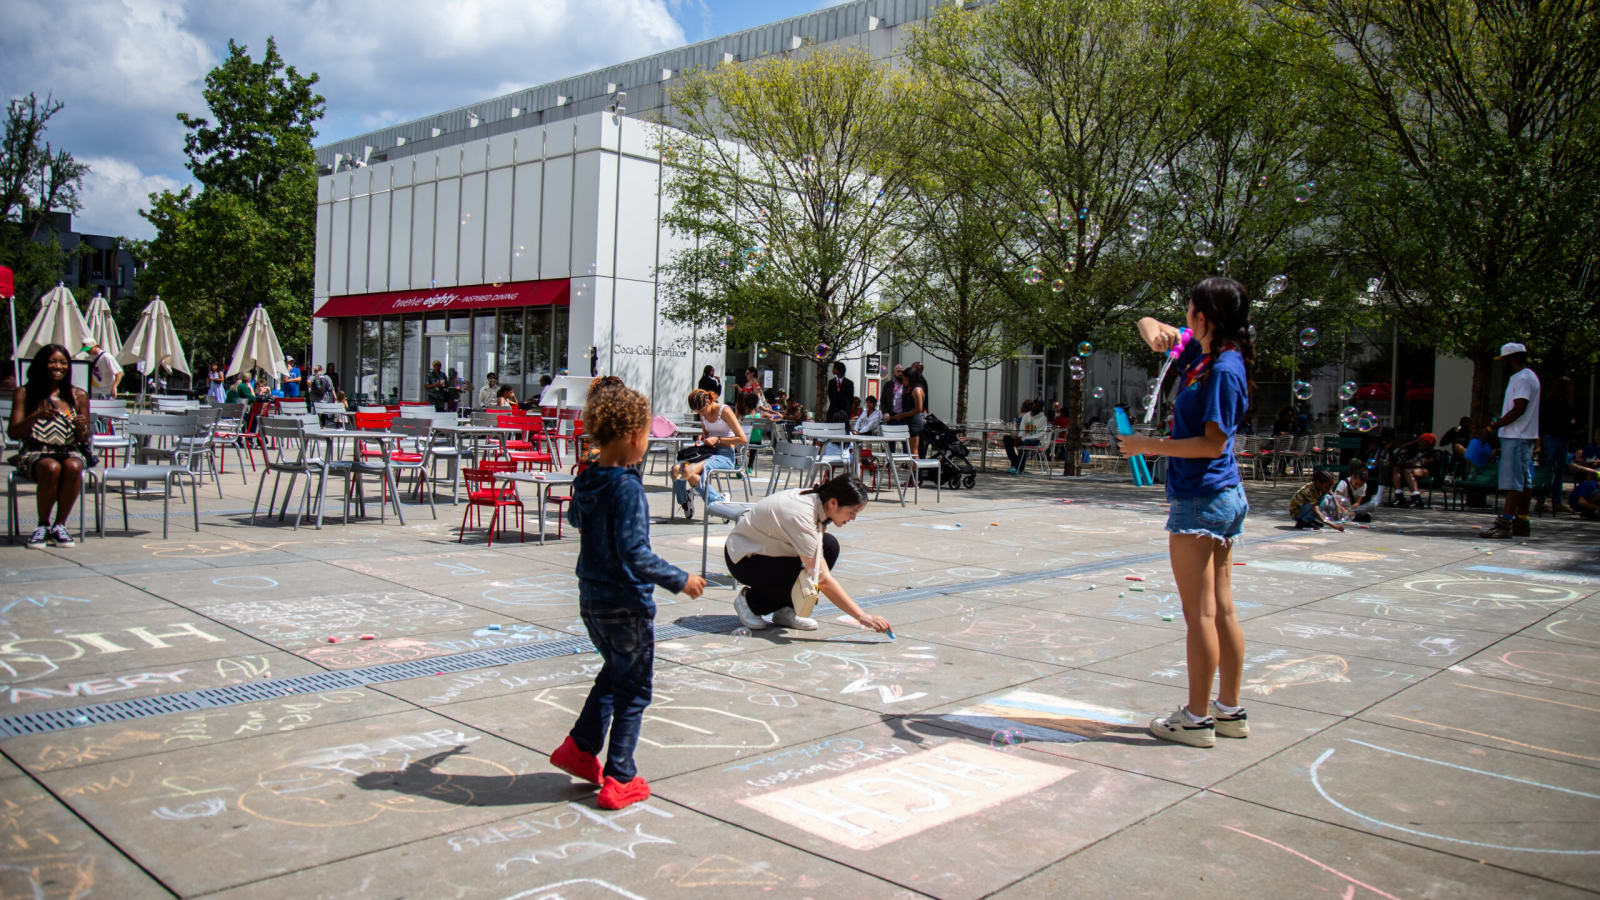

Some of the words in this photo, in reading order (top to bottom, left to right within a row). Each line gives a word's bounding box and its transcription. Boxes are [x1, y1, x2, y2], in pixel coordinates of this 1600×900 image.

[392, 296, 424, 308] twelve
[423, 292, 459, 308] eighty
[460, 294, 492, 303] INSPIRED
[491, 292, 519, 301] DINING
[613, 343, 655, 356] Coca-Cola
[656, 346, 687, 358] Pavilion
